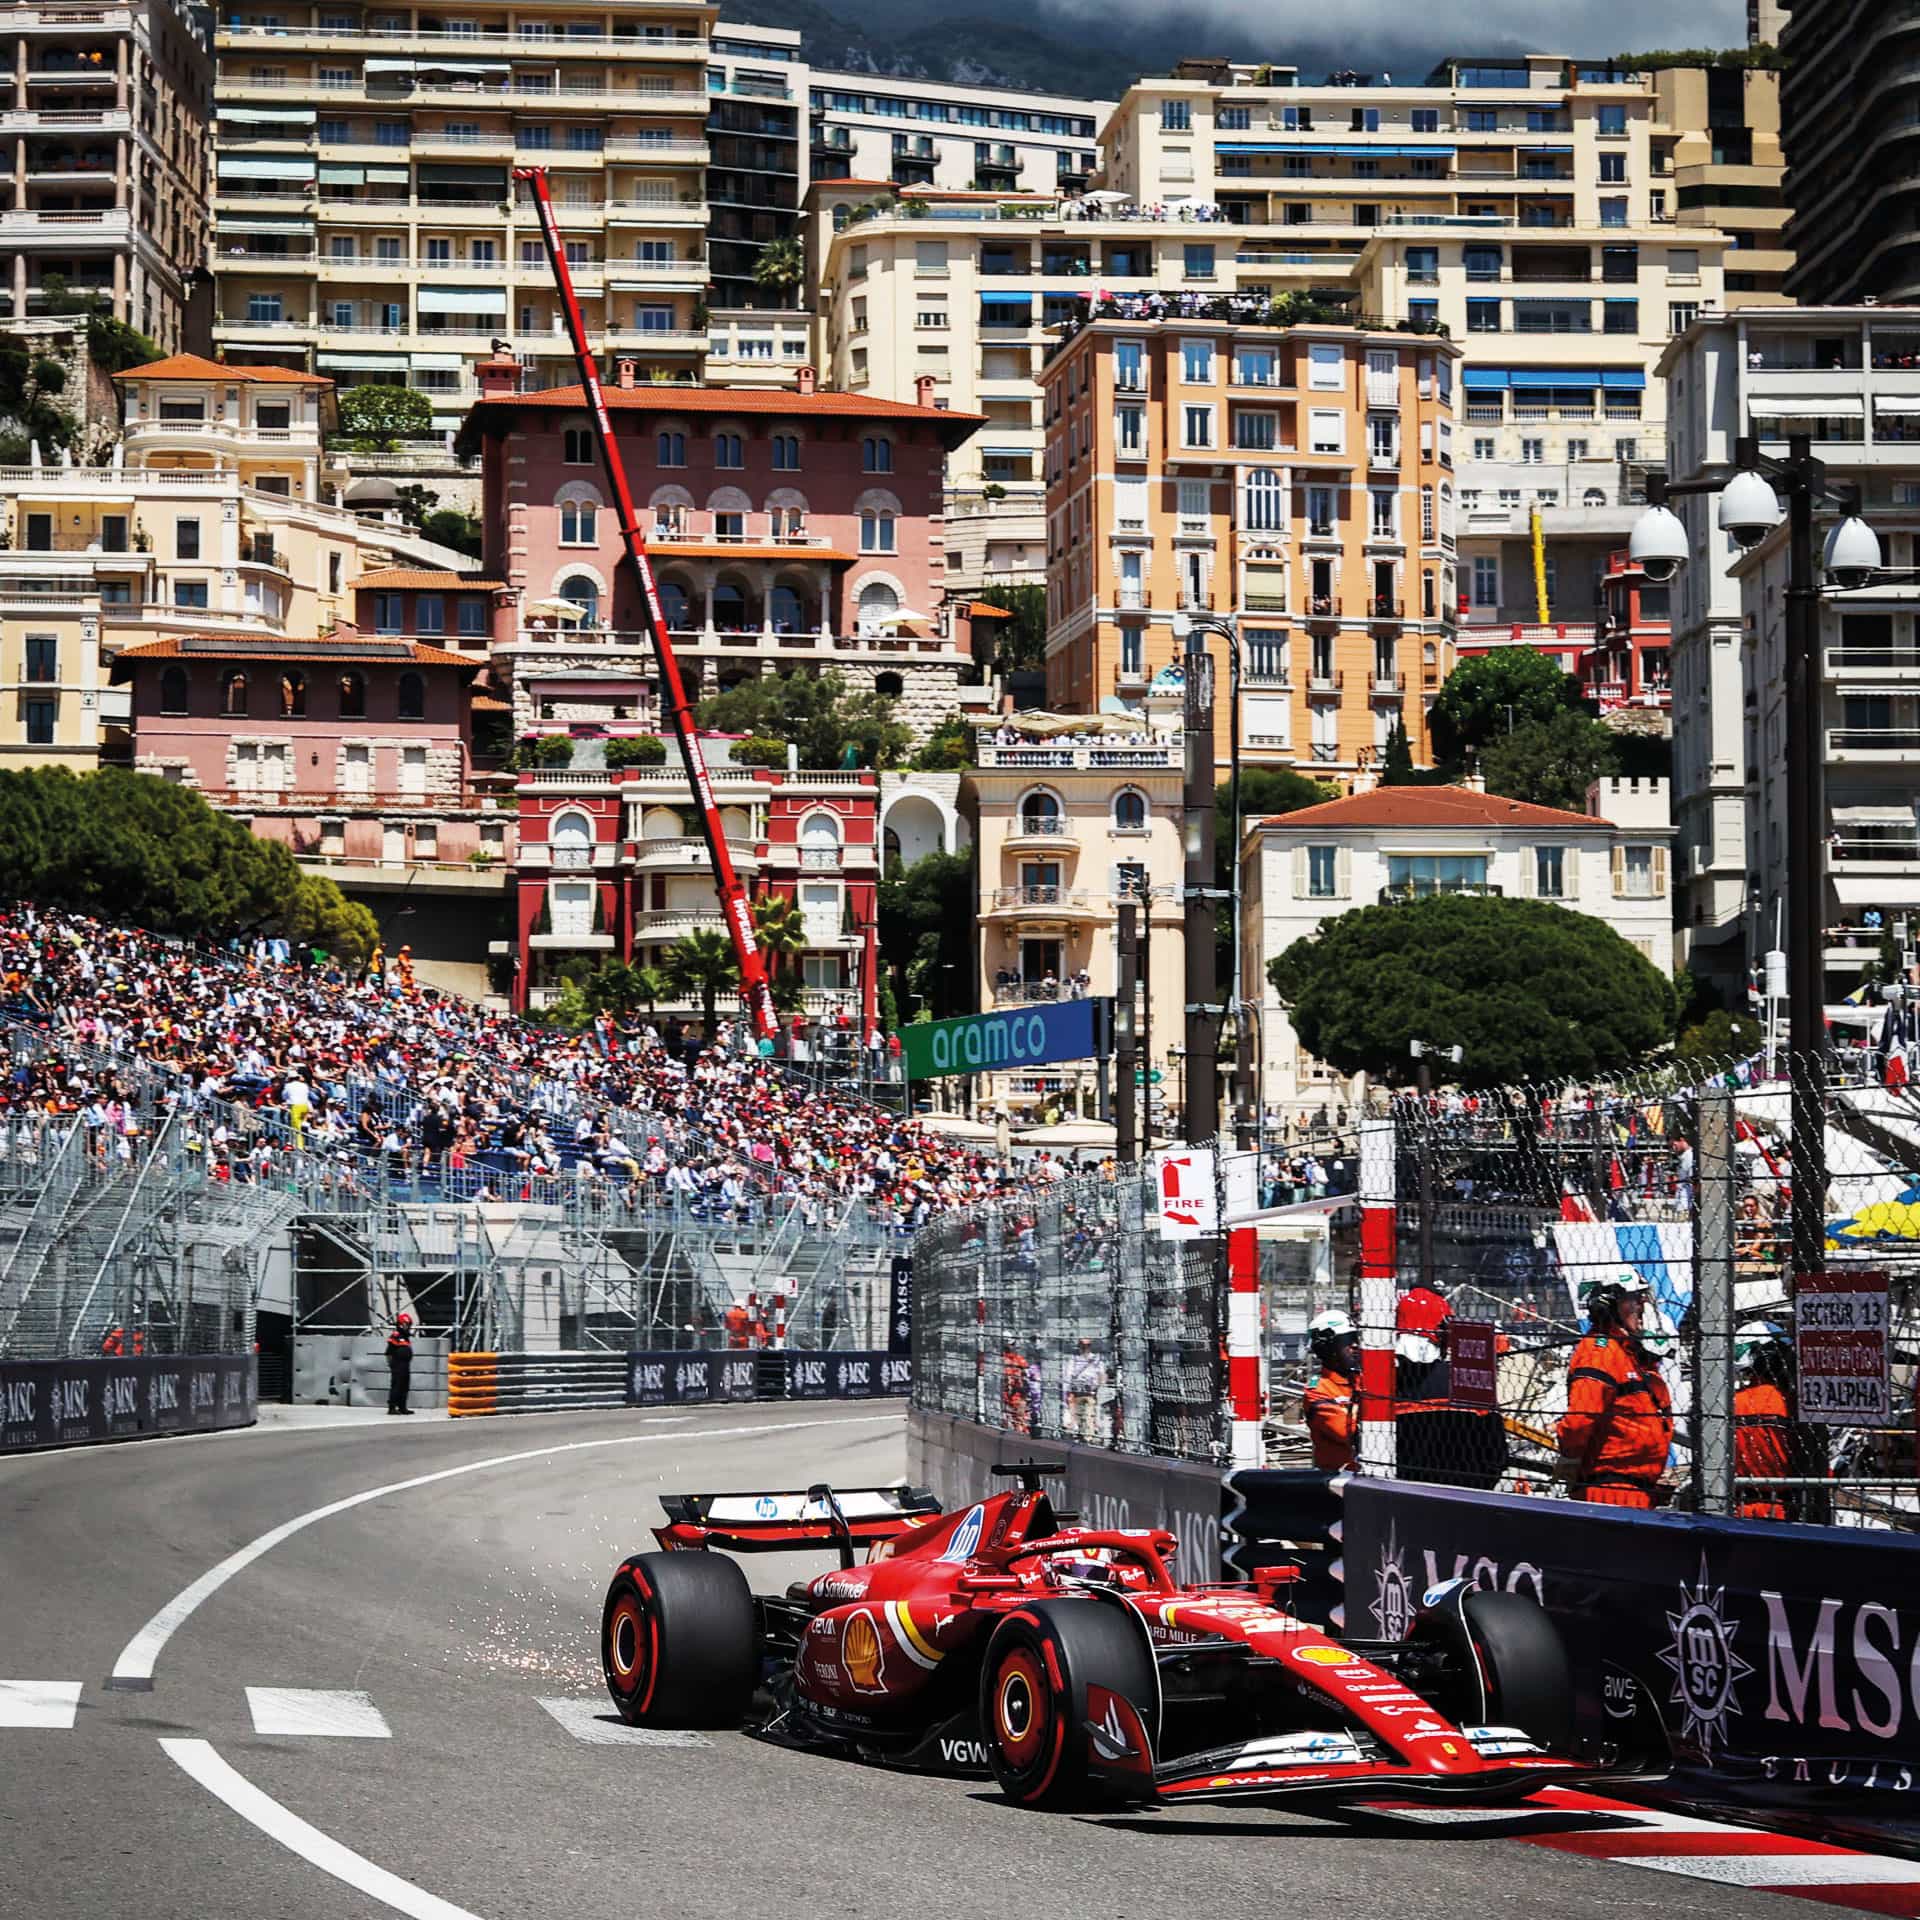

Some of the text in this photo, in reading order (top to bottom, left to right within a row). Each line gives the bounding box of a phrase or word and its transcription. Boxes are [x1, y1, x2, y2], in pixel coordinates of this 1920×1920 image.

[733, 899, 757, 955] IMPERIAL
[932, 1014, 1046, 1069] aramco
[1163, 1199, 1206, 1208] FIRE
[897, 1271, 909, 1314] MSC
[1801, 1302, 1881, 1326] SECTEUR 13
[1803, 1346, 1881, 1369] INTERVENTION
[8, 1382, 36, 1422] MSC
[63, 1380, 89, 1418] MSC
[1804, 1382, 1881, 1407] 13 ALPHA
[755, 1497, 778, 1518] hp
[825, 1577, 869, 1600] Santander
[1760, 1590, 1920, 1738] MS
[1604, 1675, 1637, 1700] aws
